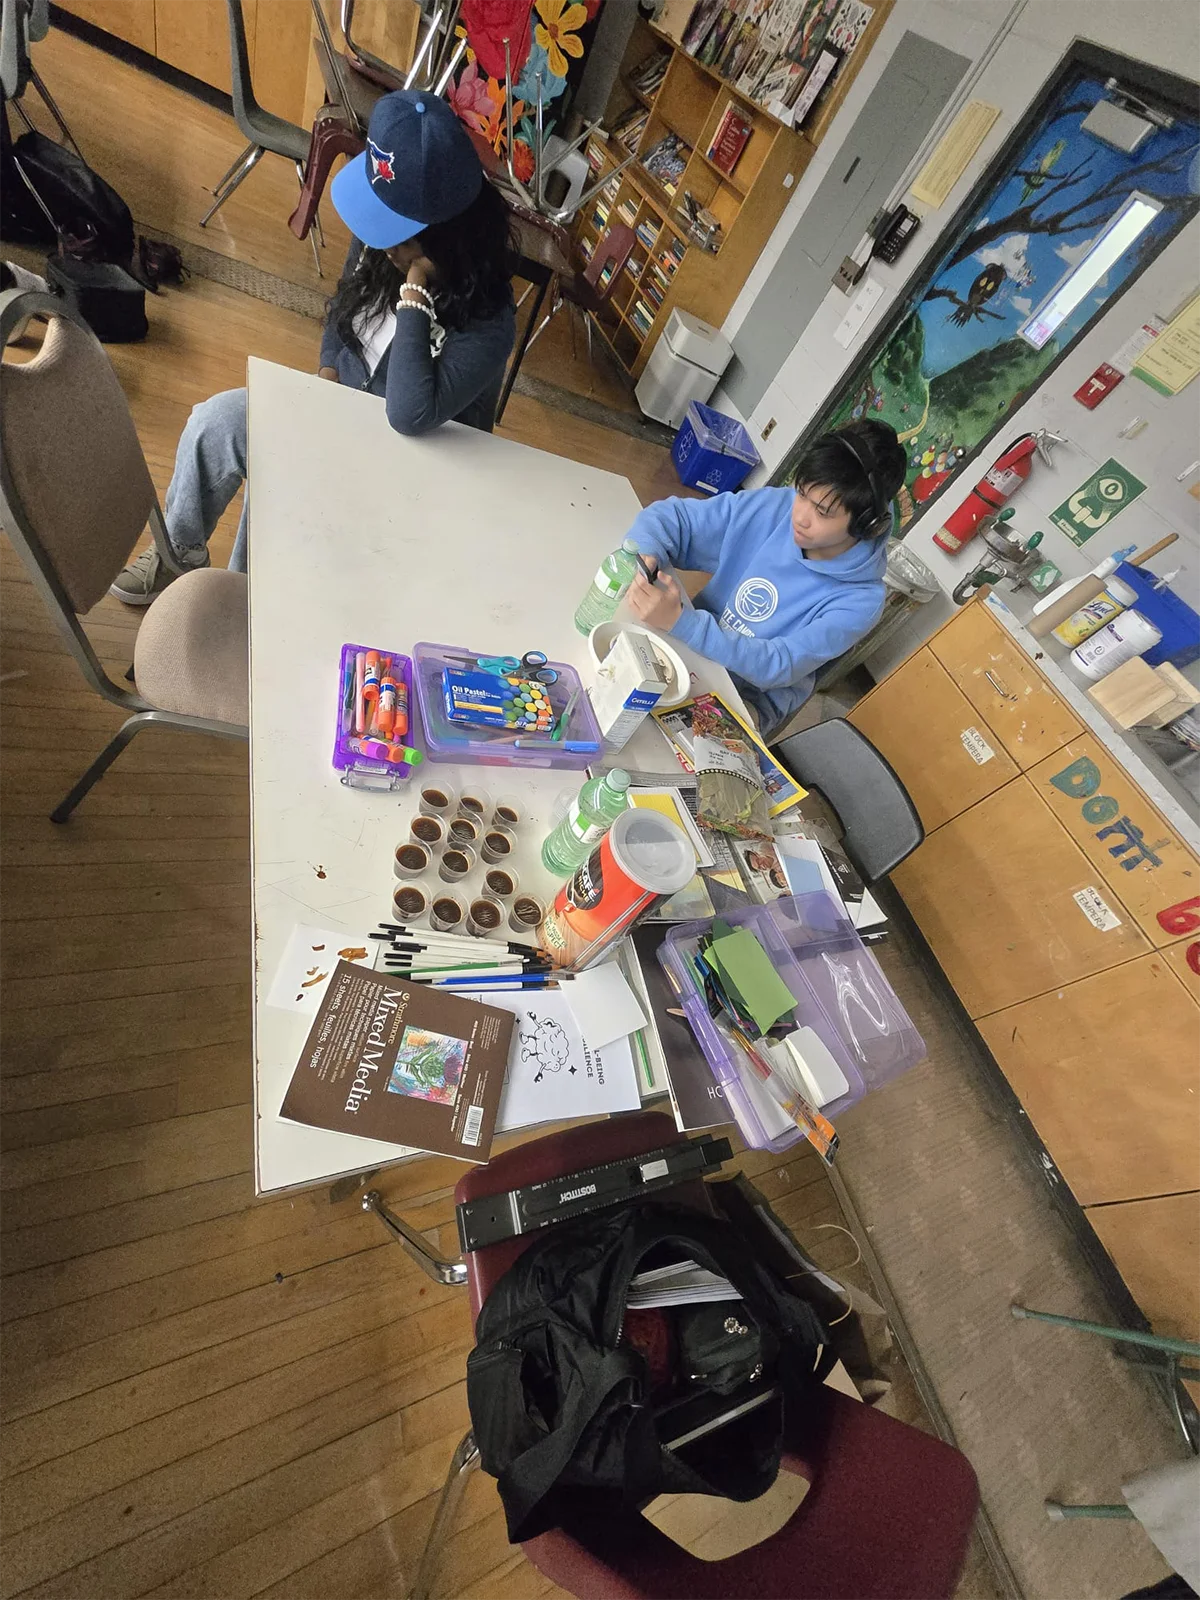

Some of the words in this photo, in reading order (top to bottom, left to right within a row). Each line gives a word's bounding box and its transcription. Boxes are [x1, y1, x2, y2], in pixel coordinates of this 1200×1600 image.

[450, 684, 463, 693] Oil
[957, 733, 986, 763] TEMPERA
[965, 726, 988, 750] BLOCK
[1075, 891, 1106, 929] TEMPERA
[343, 974, 352, 984] 15
[360, 979, 370, 995] Papel
[330, 985, 347, 1012] sheets,
[366, 982, 376, 998] Papier
[373, 984, 383, 999] Mixed
[356, 995, 364, 1007] para
[362, 999, 370, 1011] pour
[367, 1000, 377, 1016] media
[351, 1012, 366, 1041] techniques
[361, 1016, 371, 1032] paper
[365, 985, 403, 1048] Mixed
[387, 1001, 408, 1045] Strathmore
[318, 1014, 337, 1045] feuilles,
[342, 1031, 352, 1049] mixtas
[309, 1046, 325, 1069] hojas
[345, 1041, 356, 1060] mixtes
[593, 1048, 605, 1085] L-BEING
[344, 1046, 384, 1111] Media
[559, 1183, 597, 1203] BOSTITCH
